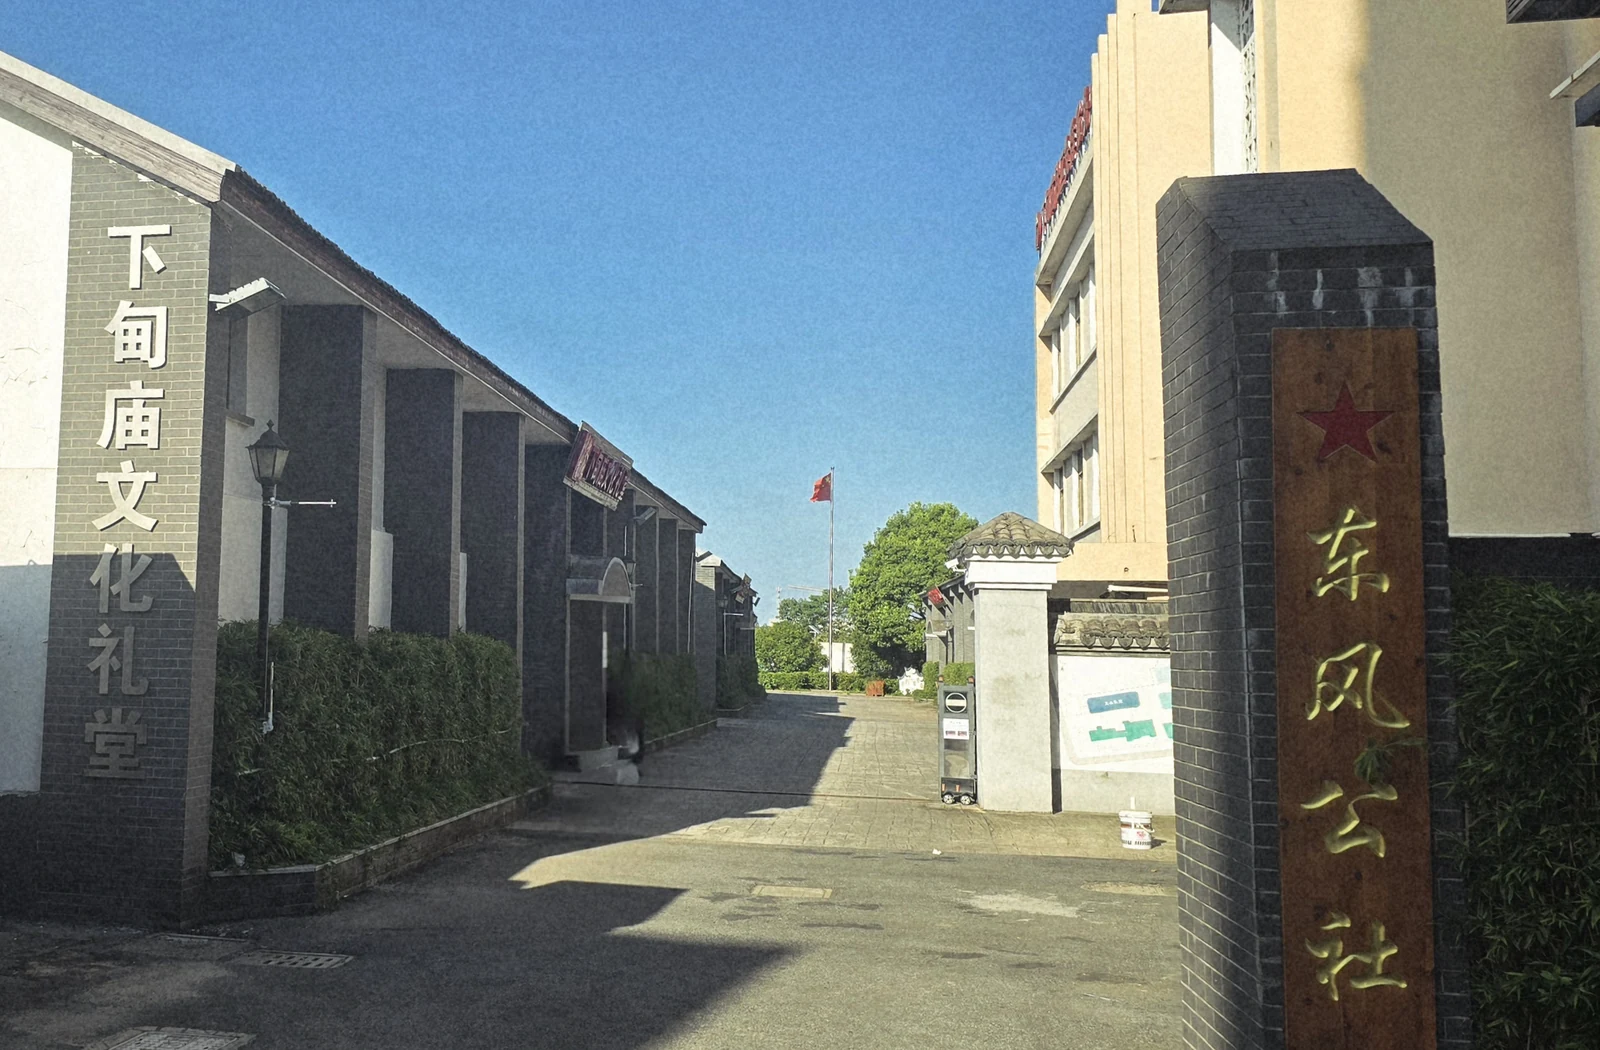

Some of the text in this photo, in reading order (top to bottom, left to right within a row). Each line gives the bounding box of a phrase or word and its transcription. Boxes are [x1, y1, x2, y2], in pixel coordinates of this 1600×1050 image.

[83, 224, 172, 779] 下甸庙文化礼堂
[1300, 506, 1411, 1002] 东风公社
